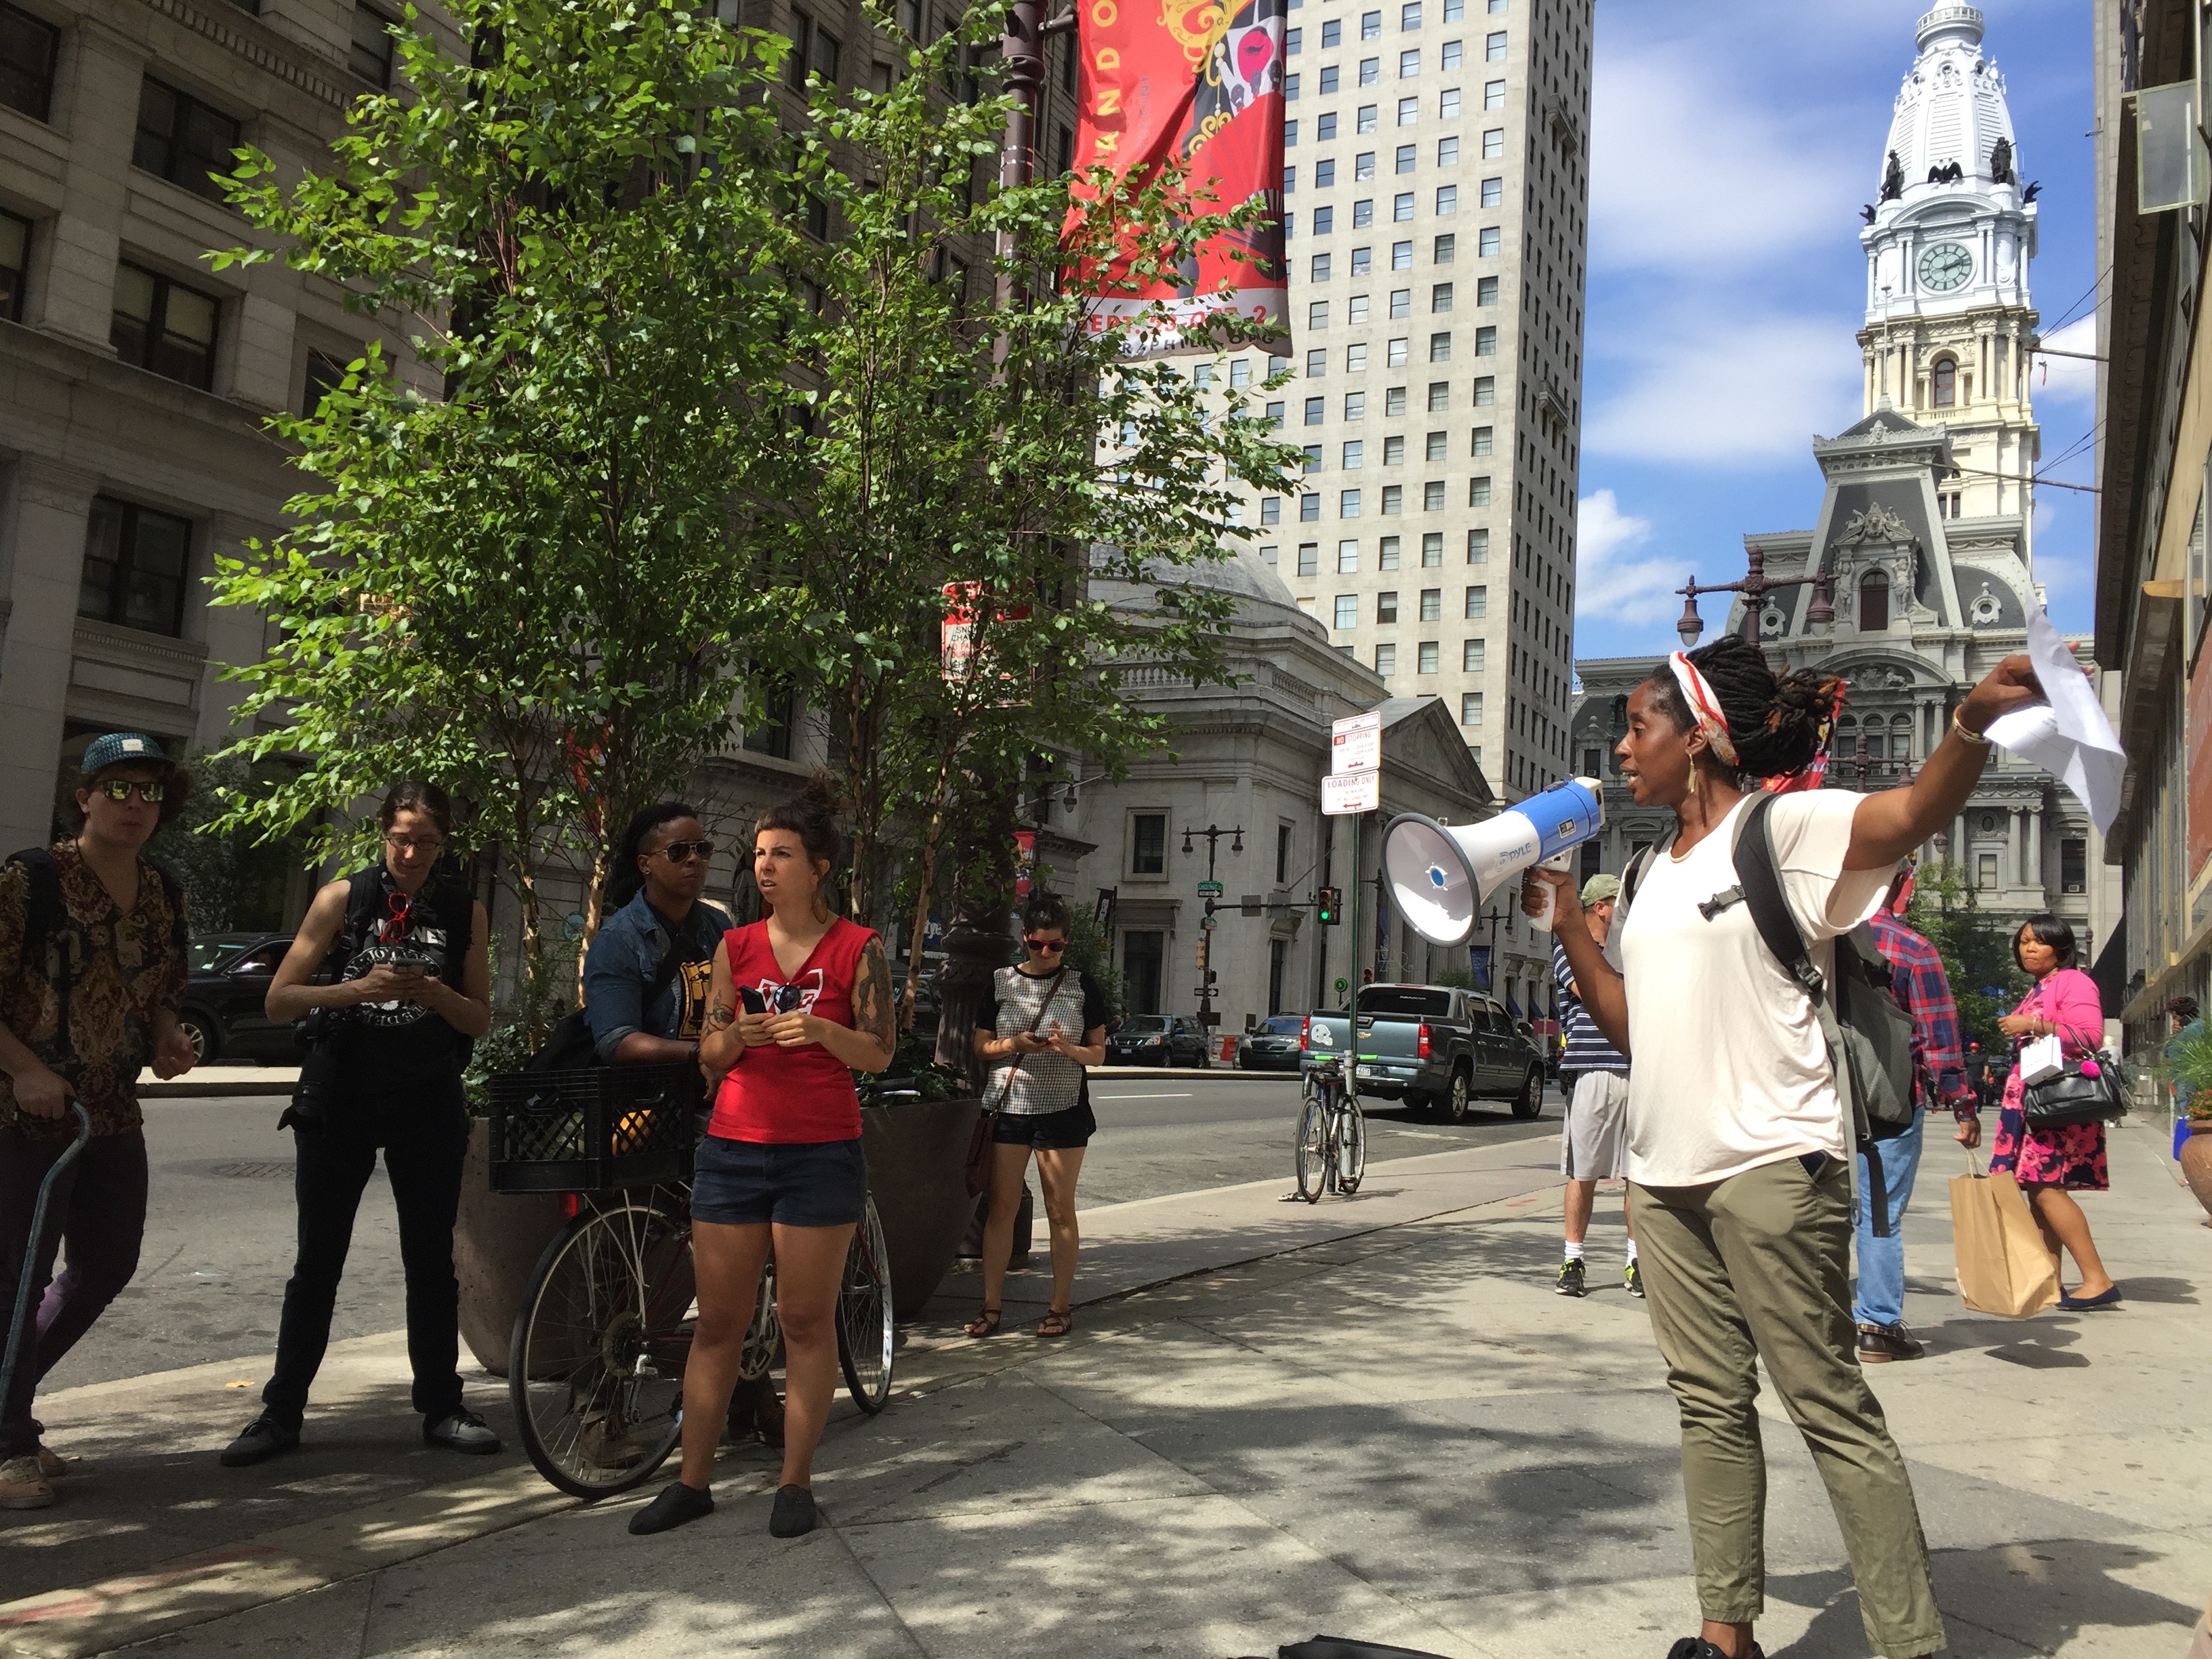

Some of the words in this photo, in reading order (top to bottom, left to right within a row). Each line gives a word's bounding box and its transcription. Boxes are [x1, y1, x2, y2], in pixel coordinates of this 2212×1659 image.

[1336, 736, 1345, 744] NO
[1347, 731, 1371, 743] STOPPING
[1328, 779, 1359, 788] LOADING
[1361, 775, 1375, 785] ONLY
[1509, 842, 1532, 861] PYLE
